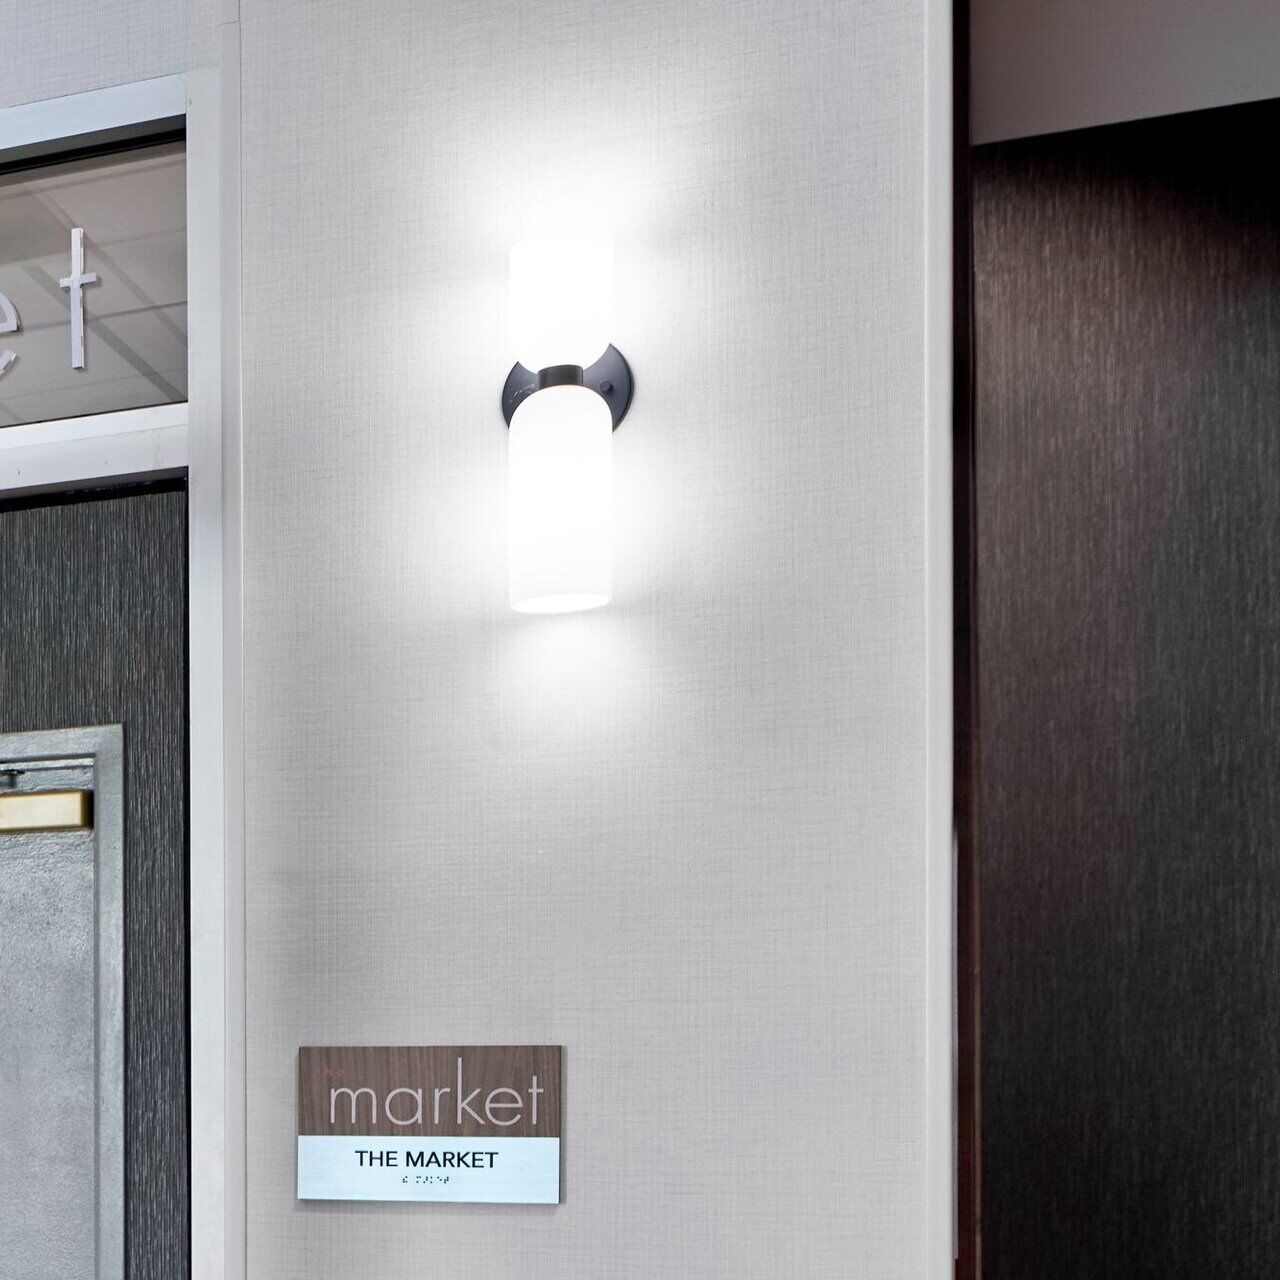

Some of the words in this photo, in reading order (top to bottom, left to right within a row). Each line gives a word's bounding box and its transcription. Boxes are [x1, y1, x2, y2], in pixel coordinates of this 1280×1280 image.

[330, 1057, 544, 1126] market
[354, 1150, 398, 1167] THE
[405, 1151, 499, 1168] MARKET
